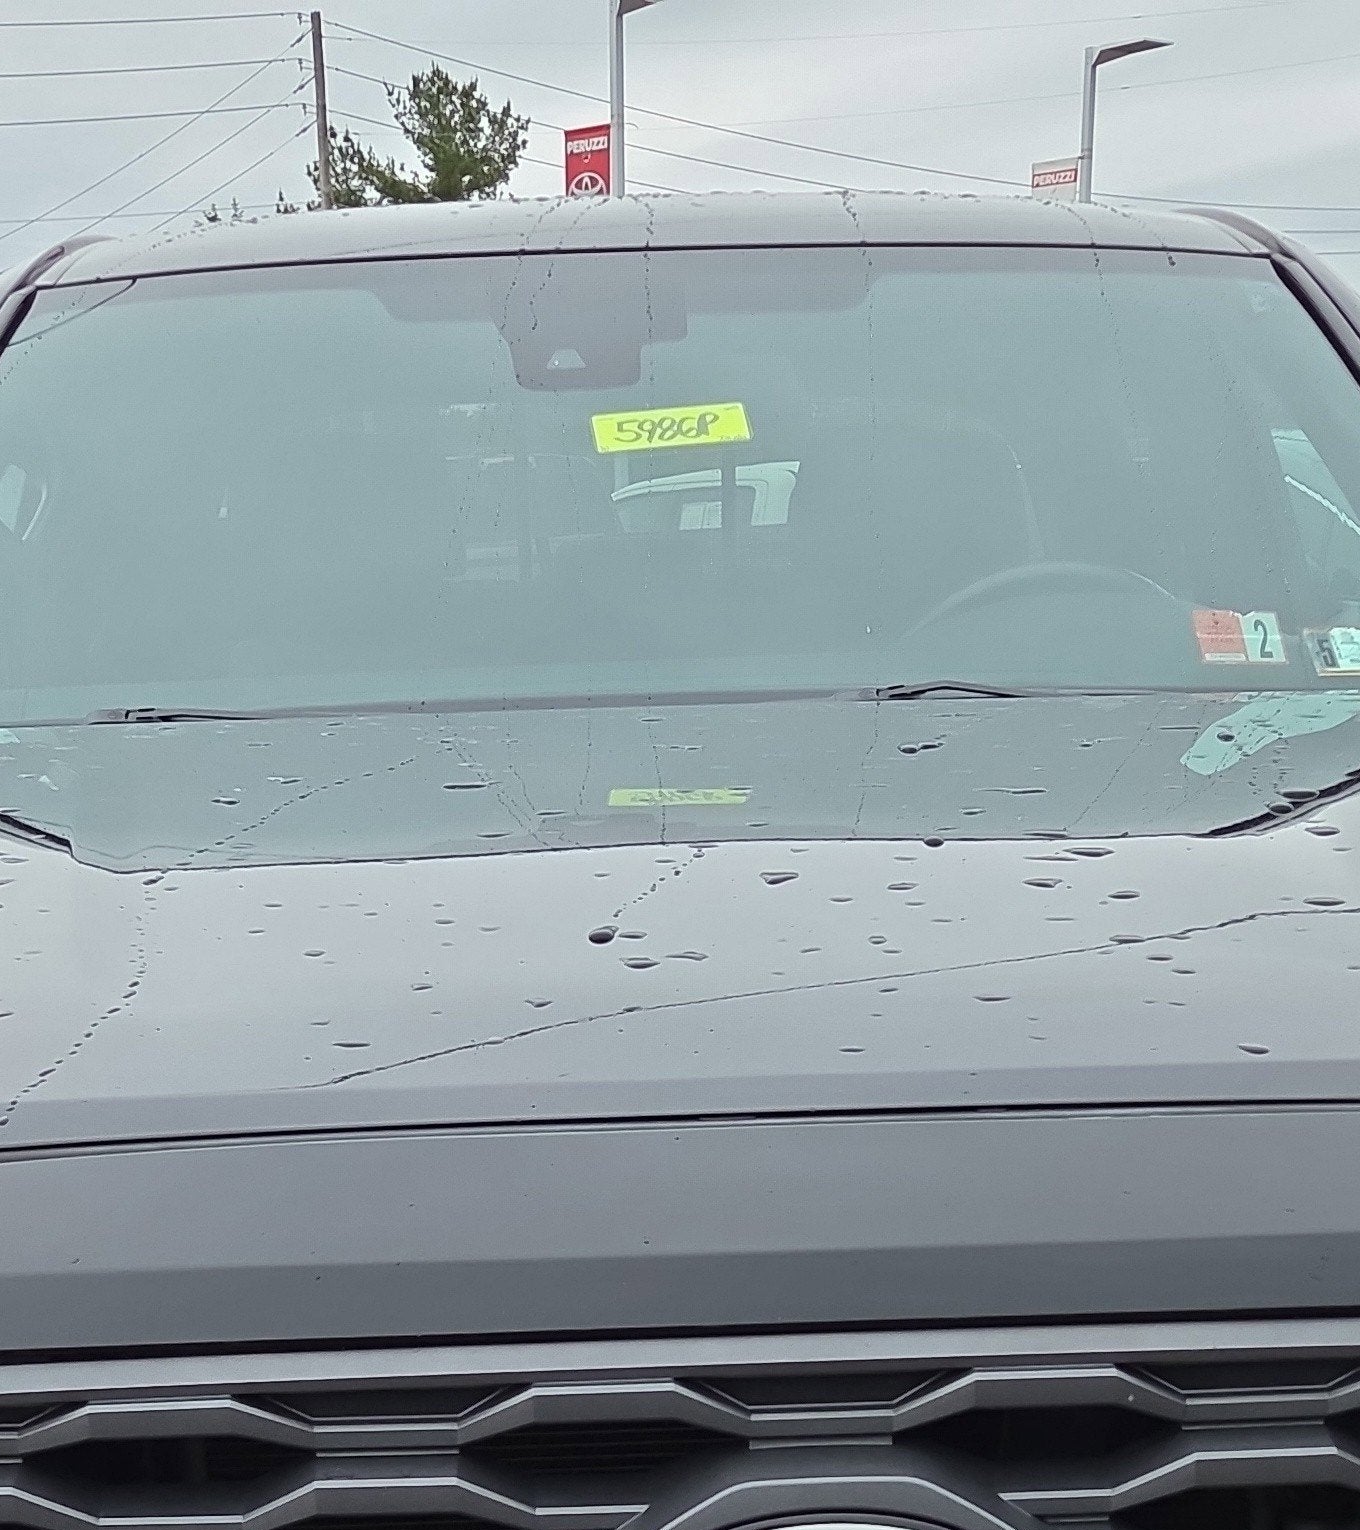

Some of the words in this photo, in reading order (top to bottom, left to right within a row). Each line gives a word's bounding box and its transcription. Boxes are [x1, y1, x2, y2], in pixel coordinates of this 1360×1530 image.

[566, 136, 608, 155] PERUZZI
[1033, 170, 1075, 187] PERUZZI
[1253, 619, 1274, 659] 2
